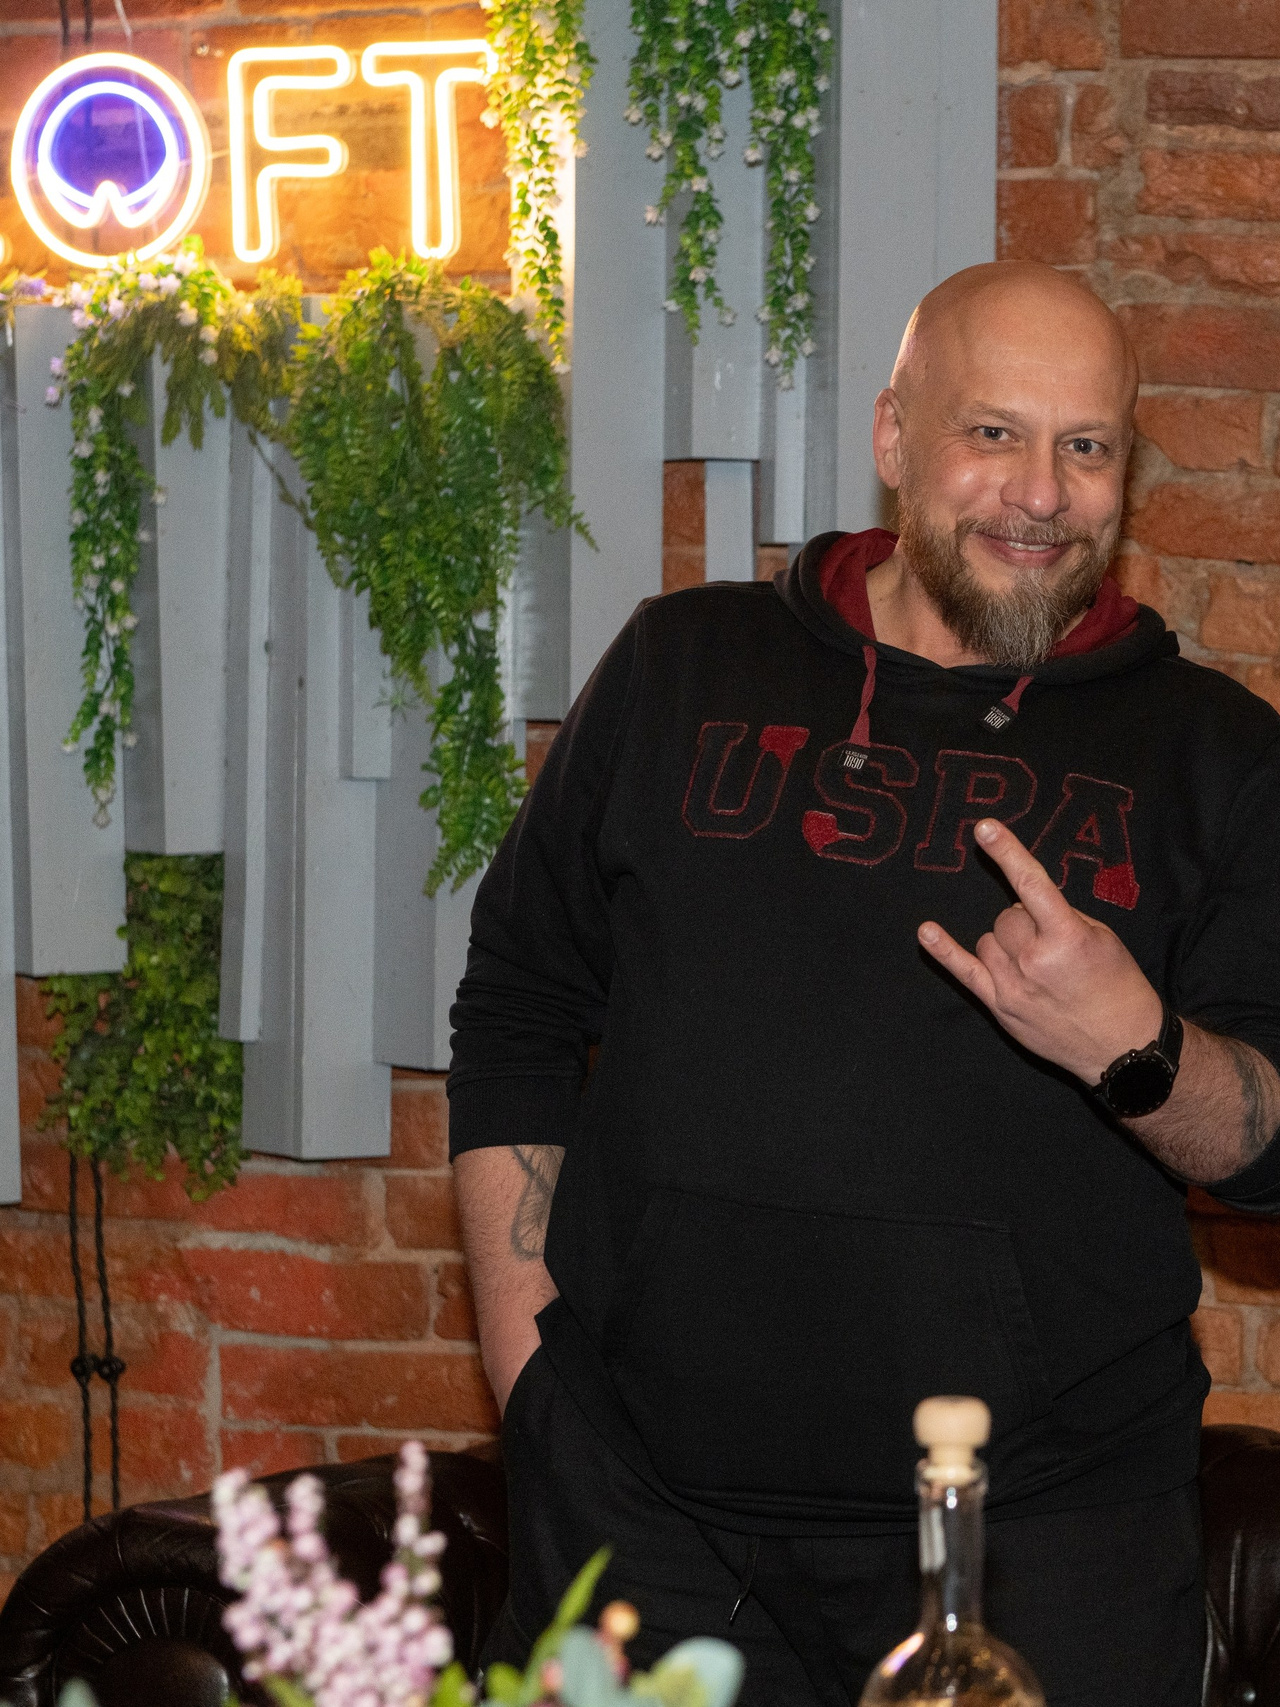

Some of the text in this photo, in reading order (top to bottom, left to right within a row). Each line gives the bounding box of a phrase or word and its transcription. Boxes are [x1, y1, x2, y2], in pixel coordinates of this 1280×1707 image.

[0, 39, 500, 268] OFT
[843, 755, 865, 770] 1890
[984, 711, 1006, 729] 1890
[682, 721, 1140, 910] USPA
